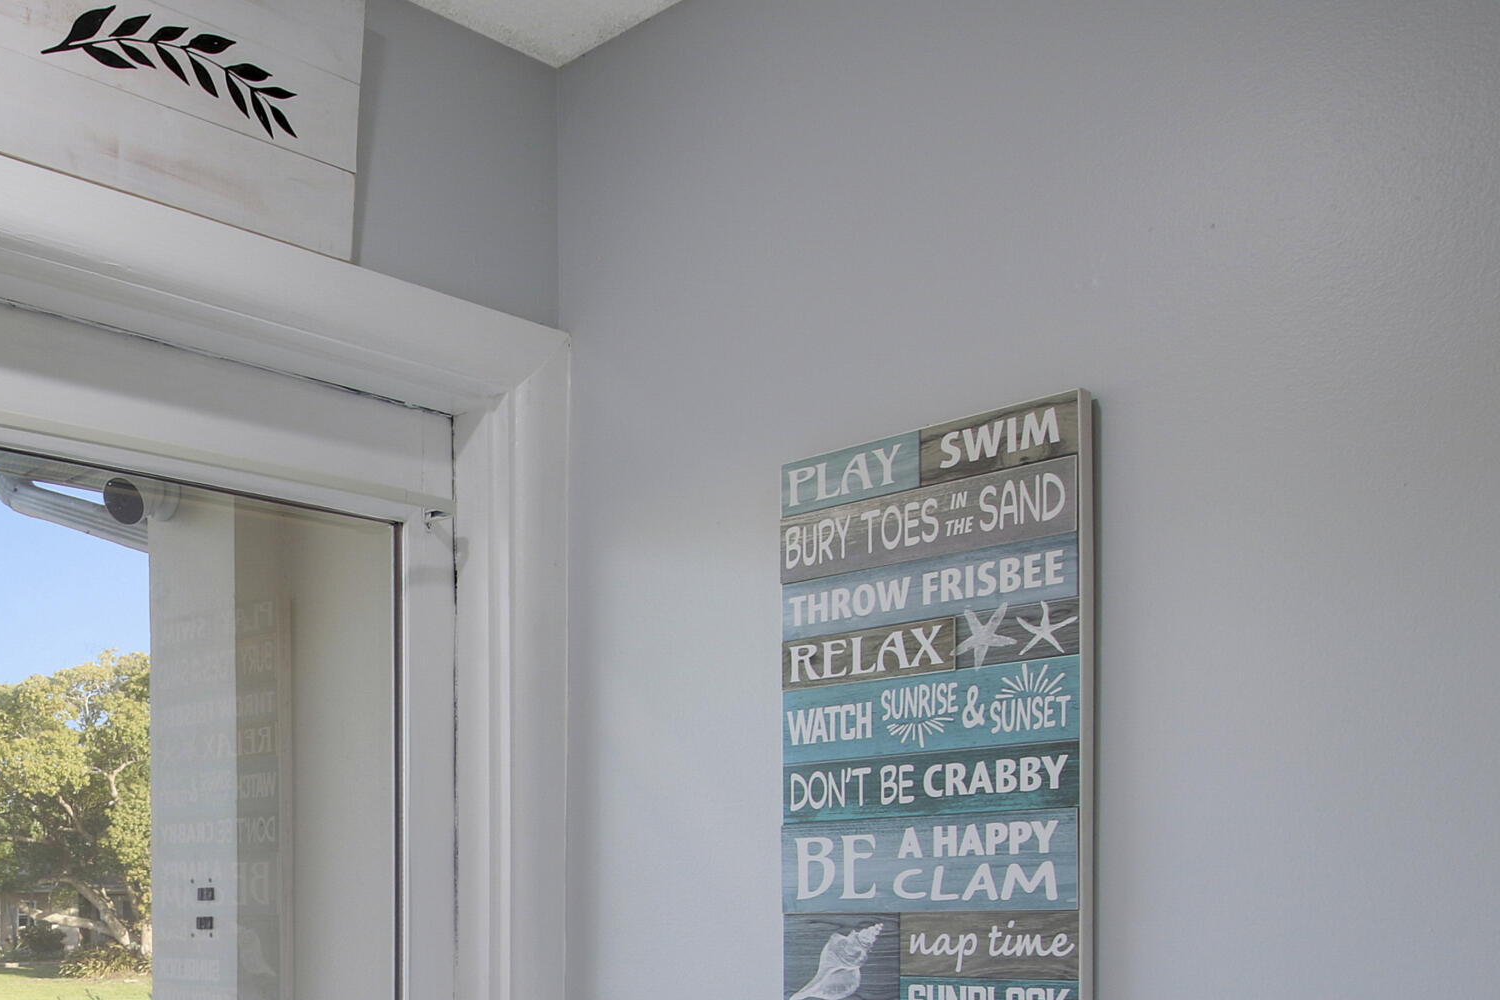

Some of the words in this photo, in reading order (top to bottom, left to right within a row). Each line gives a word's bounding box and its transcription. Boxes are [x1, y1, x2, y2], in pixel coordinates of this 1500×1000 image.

[940, 407, 1060, 469] SWIM
[788, 443, 901, 507] PLAY
[950, 491, 967, 510] IN
[979, 472, 1065, 533] SAND
[785, 514, 851, 569] BURY
[861, 497, 939, 554] TOES
[945, 516, 974, 537] THE
[788, 576, 911, 627] THROW
[922, 549, 1064, 605] FRISBEE
[789, 624, 945, 683] RELAX
[787, 702, 873, 746] WATCH
[881, 682, 959, 722] SUNRISE
[962, 685, 985, 729] &
[990, 695, 1071, 734] SUNSET
[790, 768, 871, 811] DON'T
[879, 764, 915, 806] BE
[923, 754, 1069, 797] CRABBY
[794, 834, 877, 900] BE
[898, 826, 923, 859] A
[933, 820, 1059, 858] HAPPY
[892, 860, 1058, 902] CLAM
[908, 932, 978, 973] nap
[988, 920, 1076, 958] time
